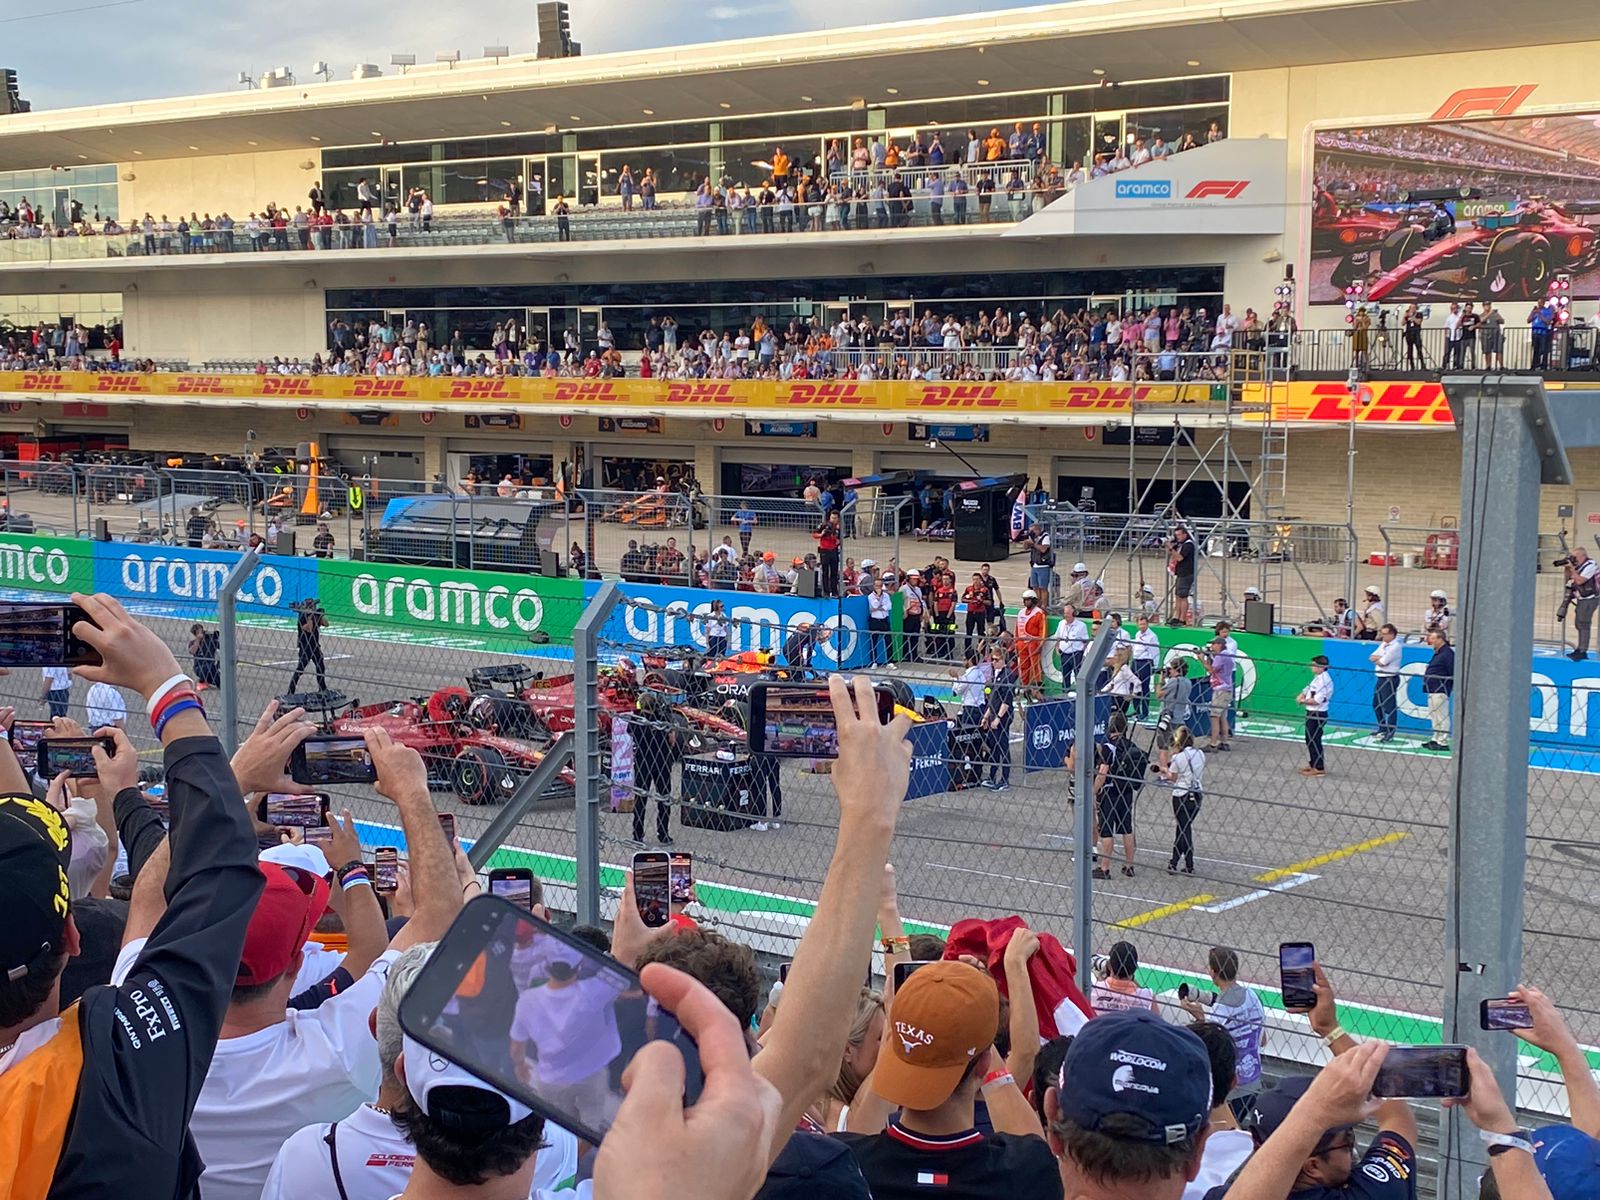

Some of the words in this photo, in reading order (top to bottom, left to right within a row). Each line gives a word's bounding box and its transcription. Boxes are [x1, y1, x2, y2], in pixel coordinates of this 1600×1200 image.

[1117, 184, 1169, 195] aramco
[23, 374, 65, 390] DHL
[97, 376, 142, 391] DHL
[176, 377, 225, 393] DHL
[262, 378, 313, 395] DHL
[353, 380, 408, 397] DHL
[451, 381, 509, 398] DHL
[555, 383, 617, 400] DHL
[667, 384, 735, 403] DHL
[789, 384, 863, 404] DHL
[920, 386, 1001, 406] DHL
[352, 573, 544, 632] aramco
[740, 789, 749, 807] 2
[130, 990, 167, 1042] FxPro
[895, 1021, 935, 1045] TEXAS
[1109, 1051, 1168, 1071] WORLDCOM
[369, 1153, 416, 1161] SCUDERI
[388, 1160, 414, 1168] FERR
